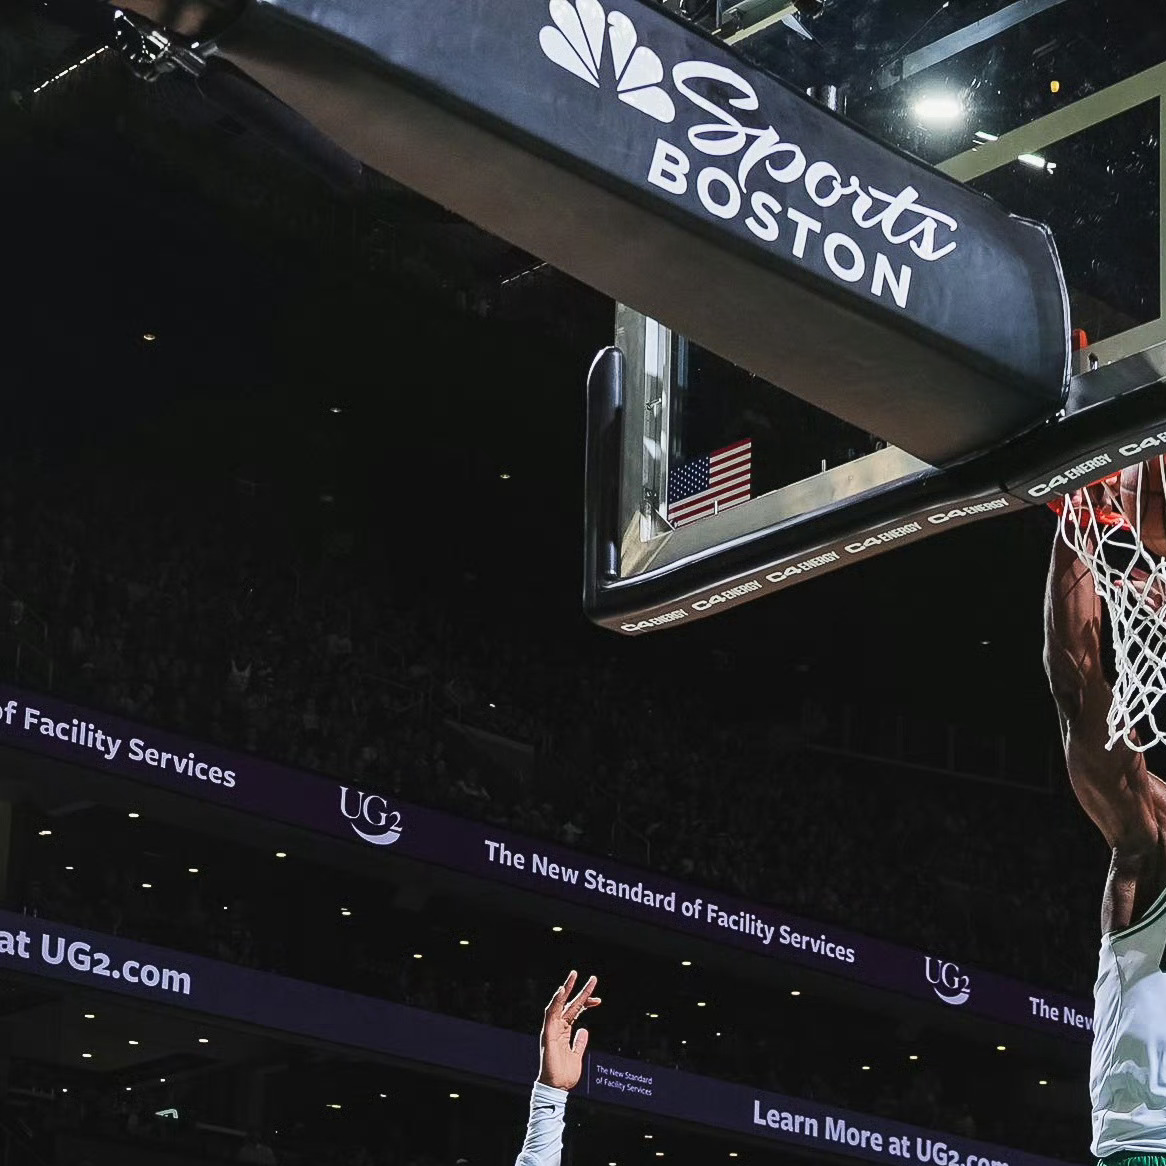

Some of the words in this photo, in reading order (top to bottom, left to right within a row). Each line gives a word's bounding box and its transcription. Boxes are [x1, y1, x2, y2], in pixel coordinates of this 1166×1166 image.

[672, 60, 957, 261] Sports
[647, 138, 912, 309] BOSTON
[1064, 453, 1112, 479] ENERGY
[962, 497, 1009, 515] ENERGY
[877, 521, 922, 542] ENERGY
[800, 551, 840, 573] ENERGY
[723, 579, 763, 599] ENERGY
[650, 608, 689, 626] ENERGY
[24, 707, 122, 761] Facility
[128, 738, 236, 789] Services
[339, 786, 403, 832] UG2
[484, 839, 526, 870] The
[531, 853, 579, 885] New
[584, 869, 676, 913] Standard
[681, 899, 703, 919] of
[706, 903, 775, 944] Facility
[779, 924, 855, 963] Services
[0, 930, 30, 958] at
[41, 934, 191, 994] UG2.com
[924, 956, 971, 993] UG2
[1029, 996, 1060, 1022] The
[595, 1077, 603, 1085] of
[603, 1078, 626, 1092] Facility
[626, 1083, 653, 1096] Services
[596, 1064, 609, 1075] The
[609, 1068, 624, 1078] New
[624, 1071, 653, 1085] Standard
[753, 1099, 819, 1137] Learn
[825, 1115, 883, 1152] More
[888, 1134, 910, 1159] at
